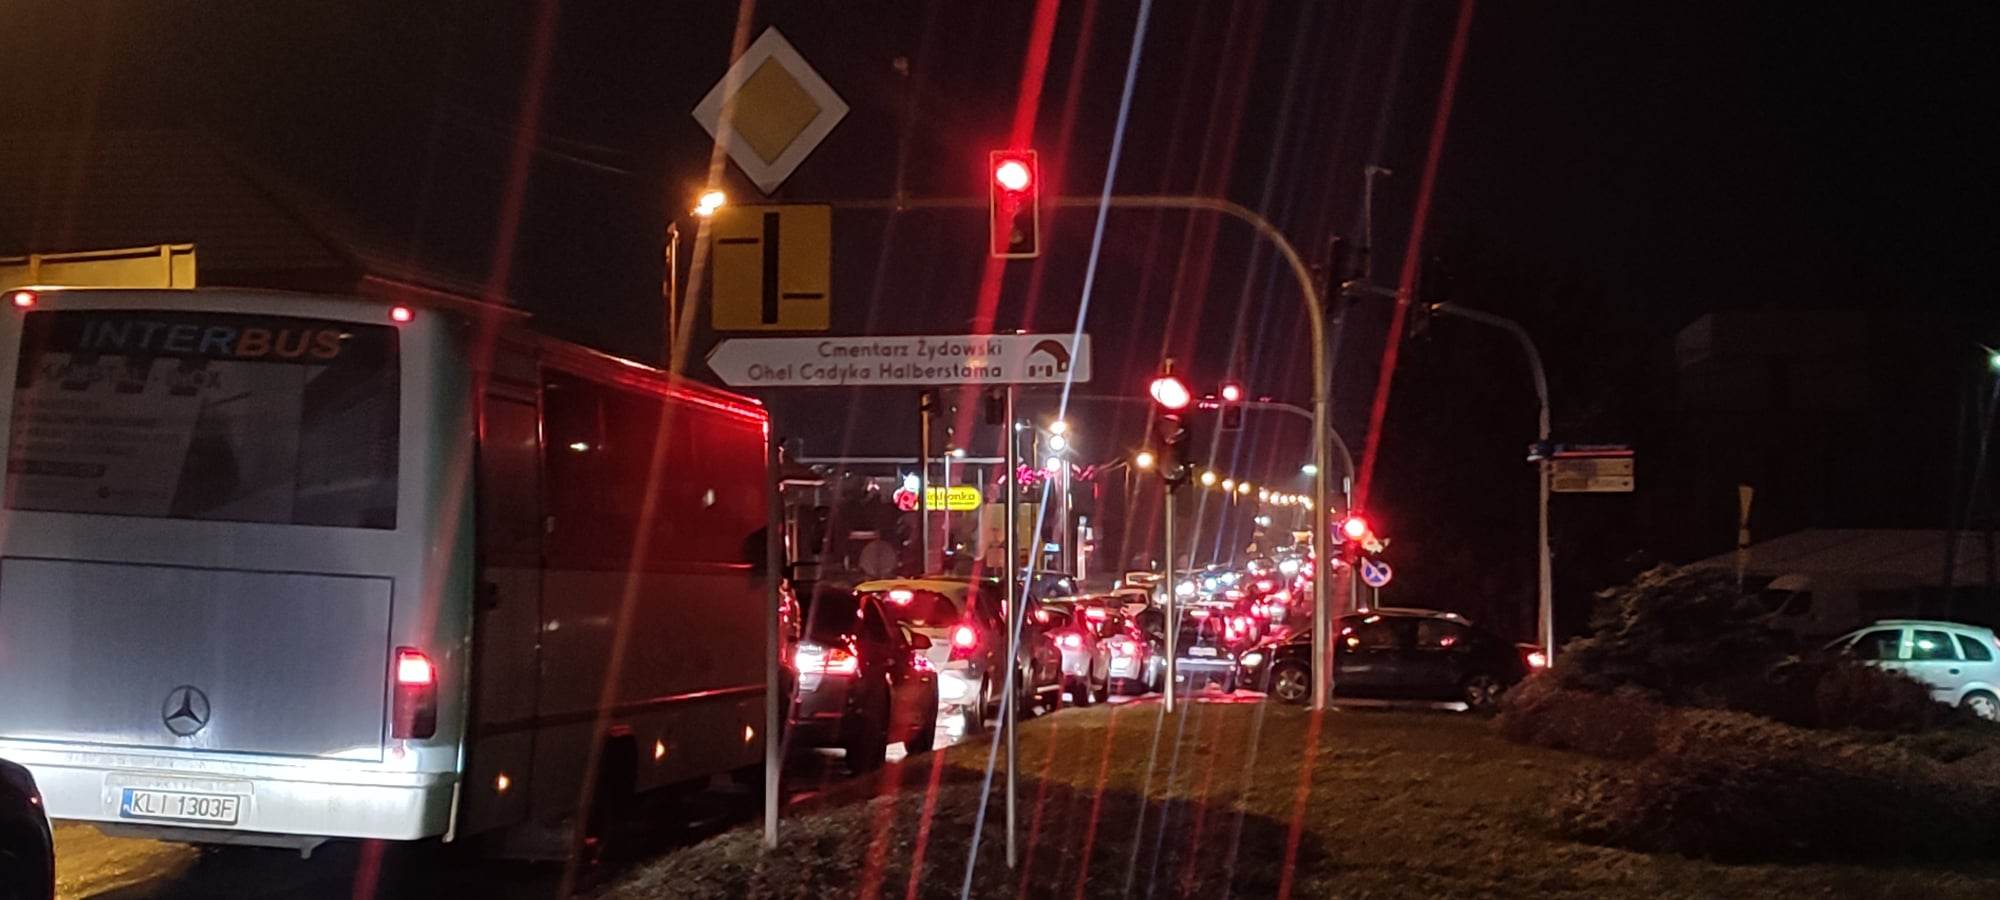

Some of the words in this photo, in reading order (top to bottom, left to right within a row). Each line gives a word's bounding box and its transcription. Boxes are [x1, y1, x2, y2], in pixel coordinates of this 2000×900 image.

[79, 319, 343, 359] INTERBUS
[817, 340, 909, 359] Cmentarz
[916, 337, 1002, 362] Żydowski
[747, 364, 793, 381] Ohel
[800, 363, 872, 385] Cadyka
[879, 361, 1002, 381] Halberstama
[132, 793, 168, 815] KLI
[178, 795, 235, 818] 1303F
